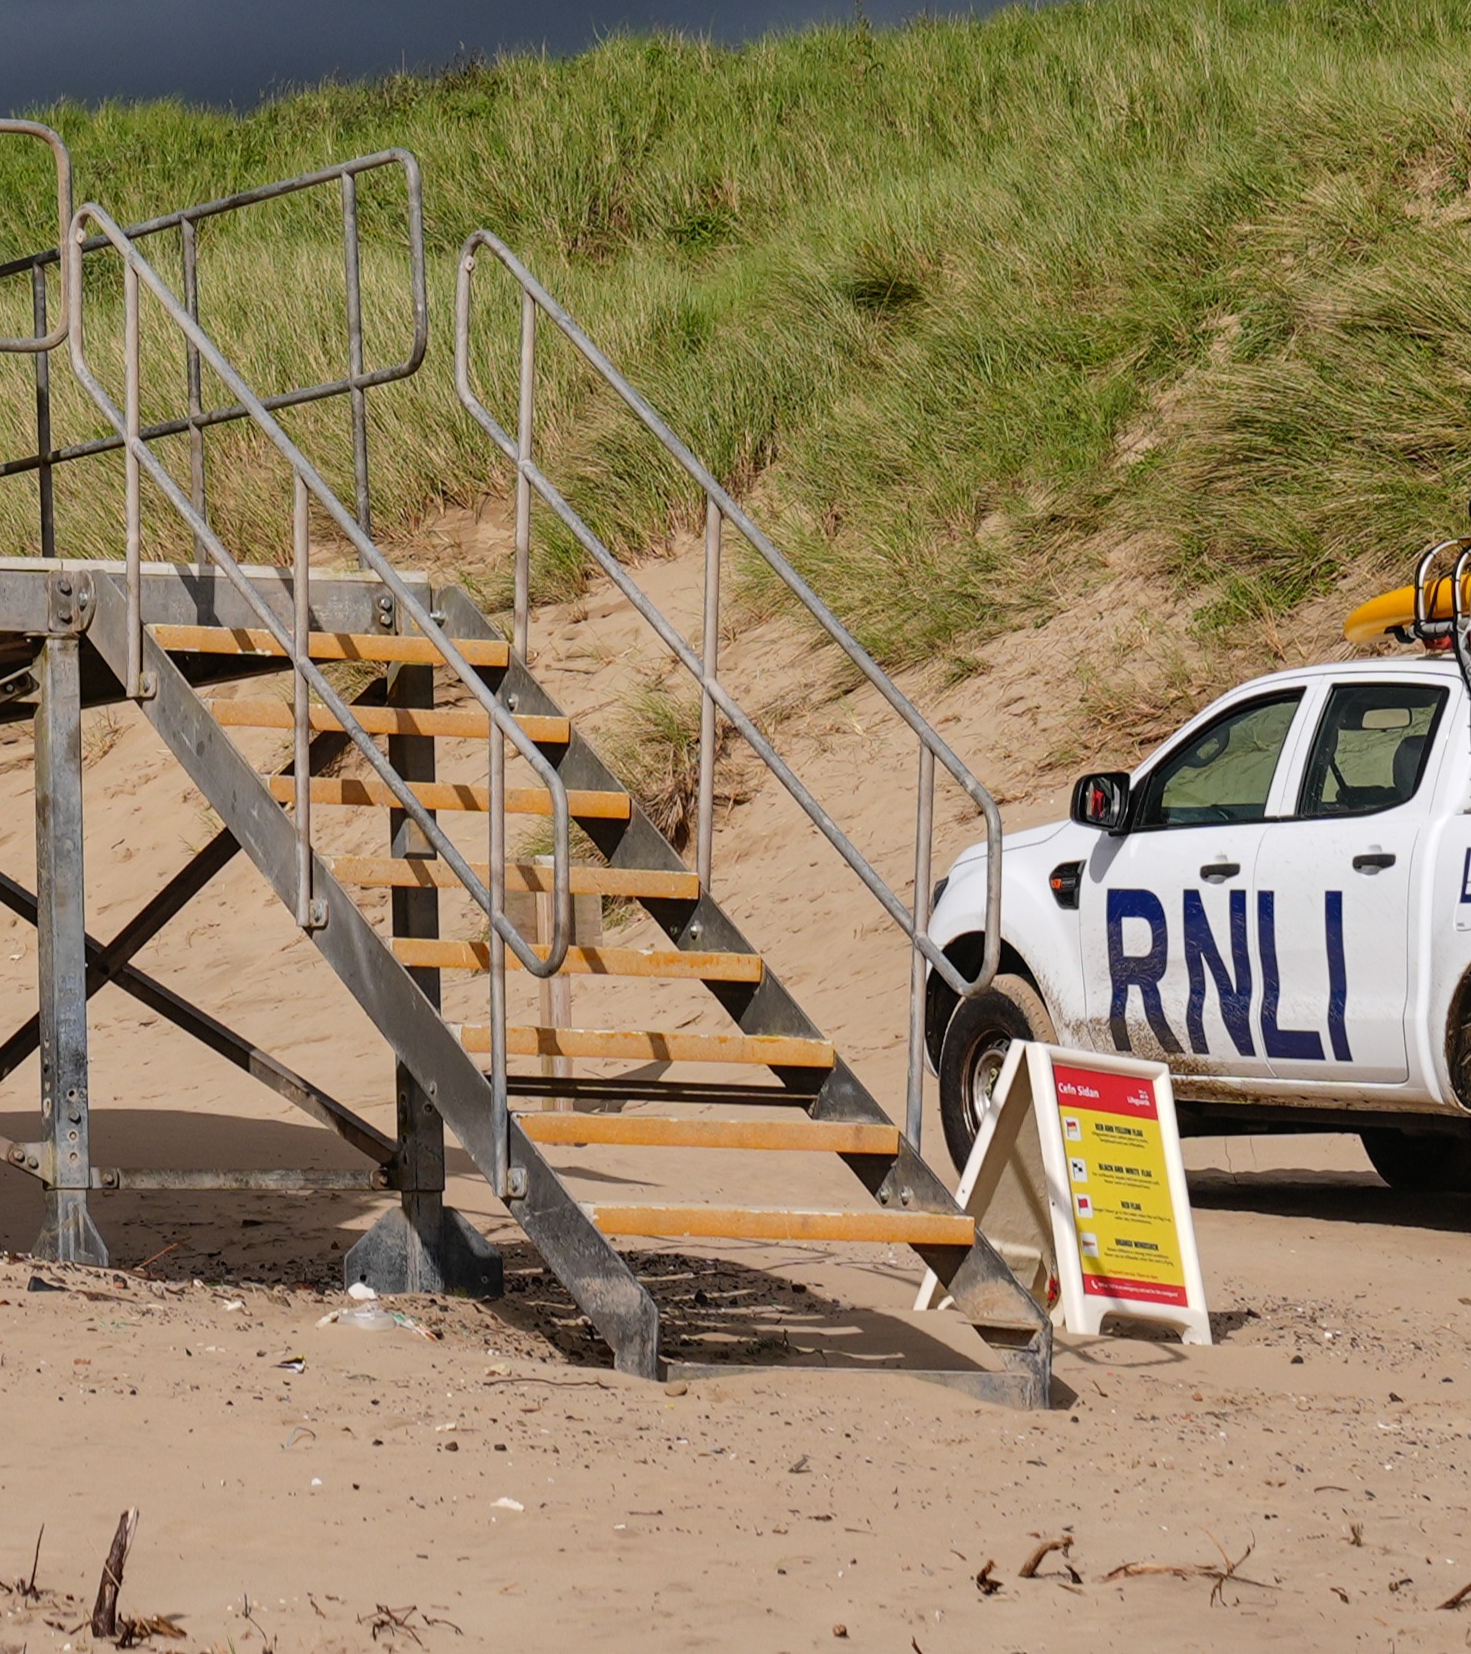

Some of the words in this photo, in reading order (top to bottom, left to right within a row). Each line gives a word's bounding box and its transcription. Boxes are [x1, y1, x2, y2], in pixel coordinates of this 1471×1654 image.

[1106, 888, 1354, 1062] RNLI
[1058, 1082, 1077, 1094] Cefn
[1077, 1084, 1100, 1098] Sidan
